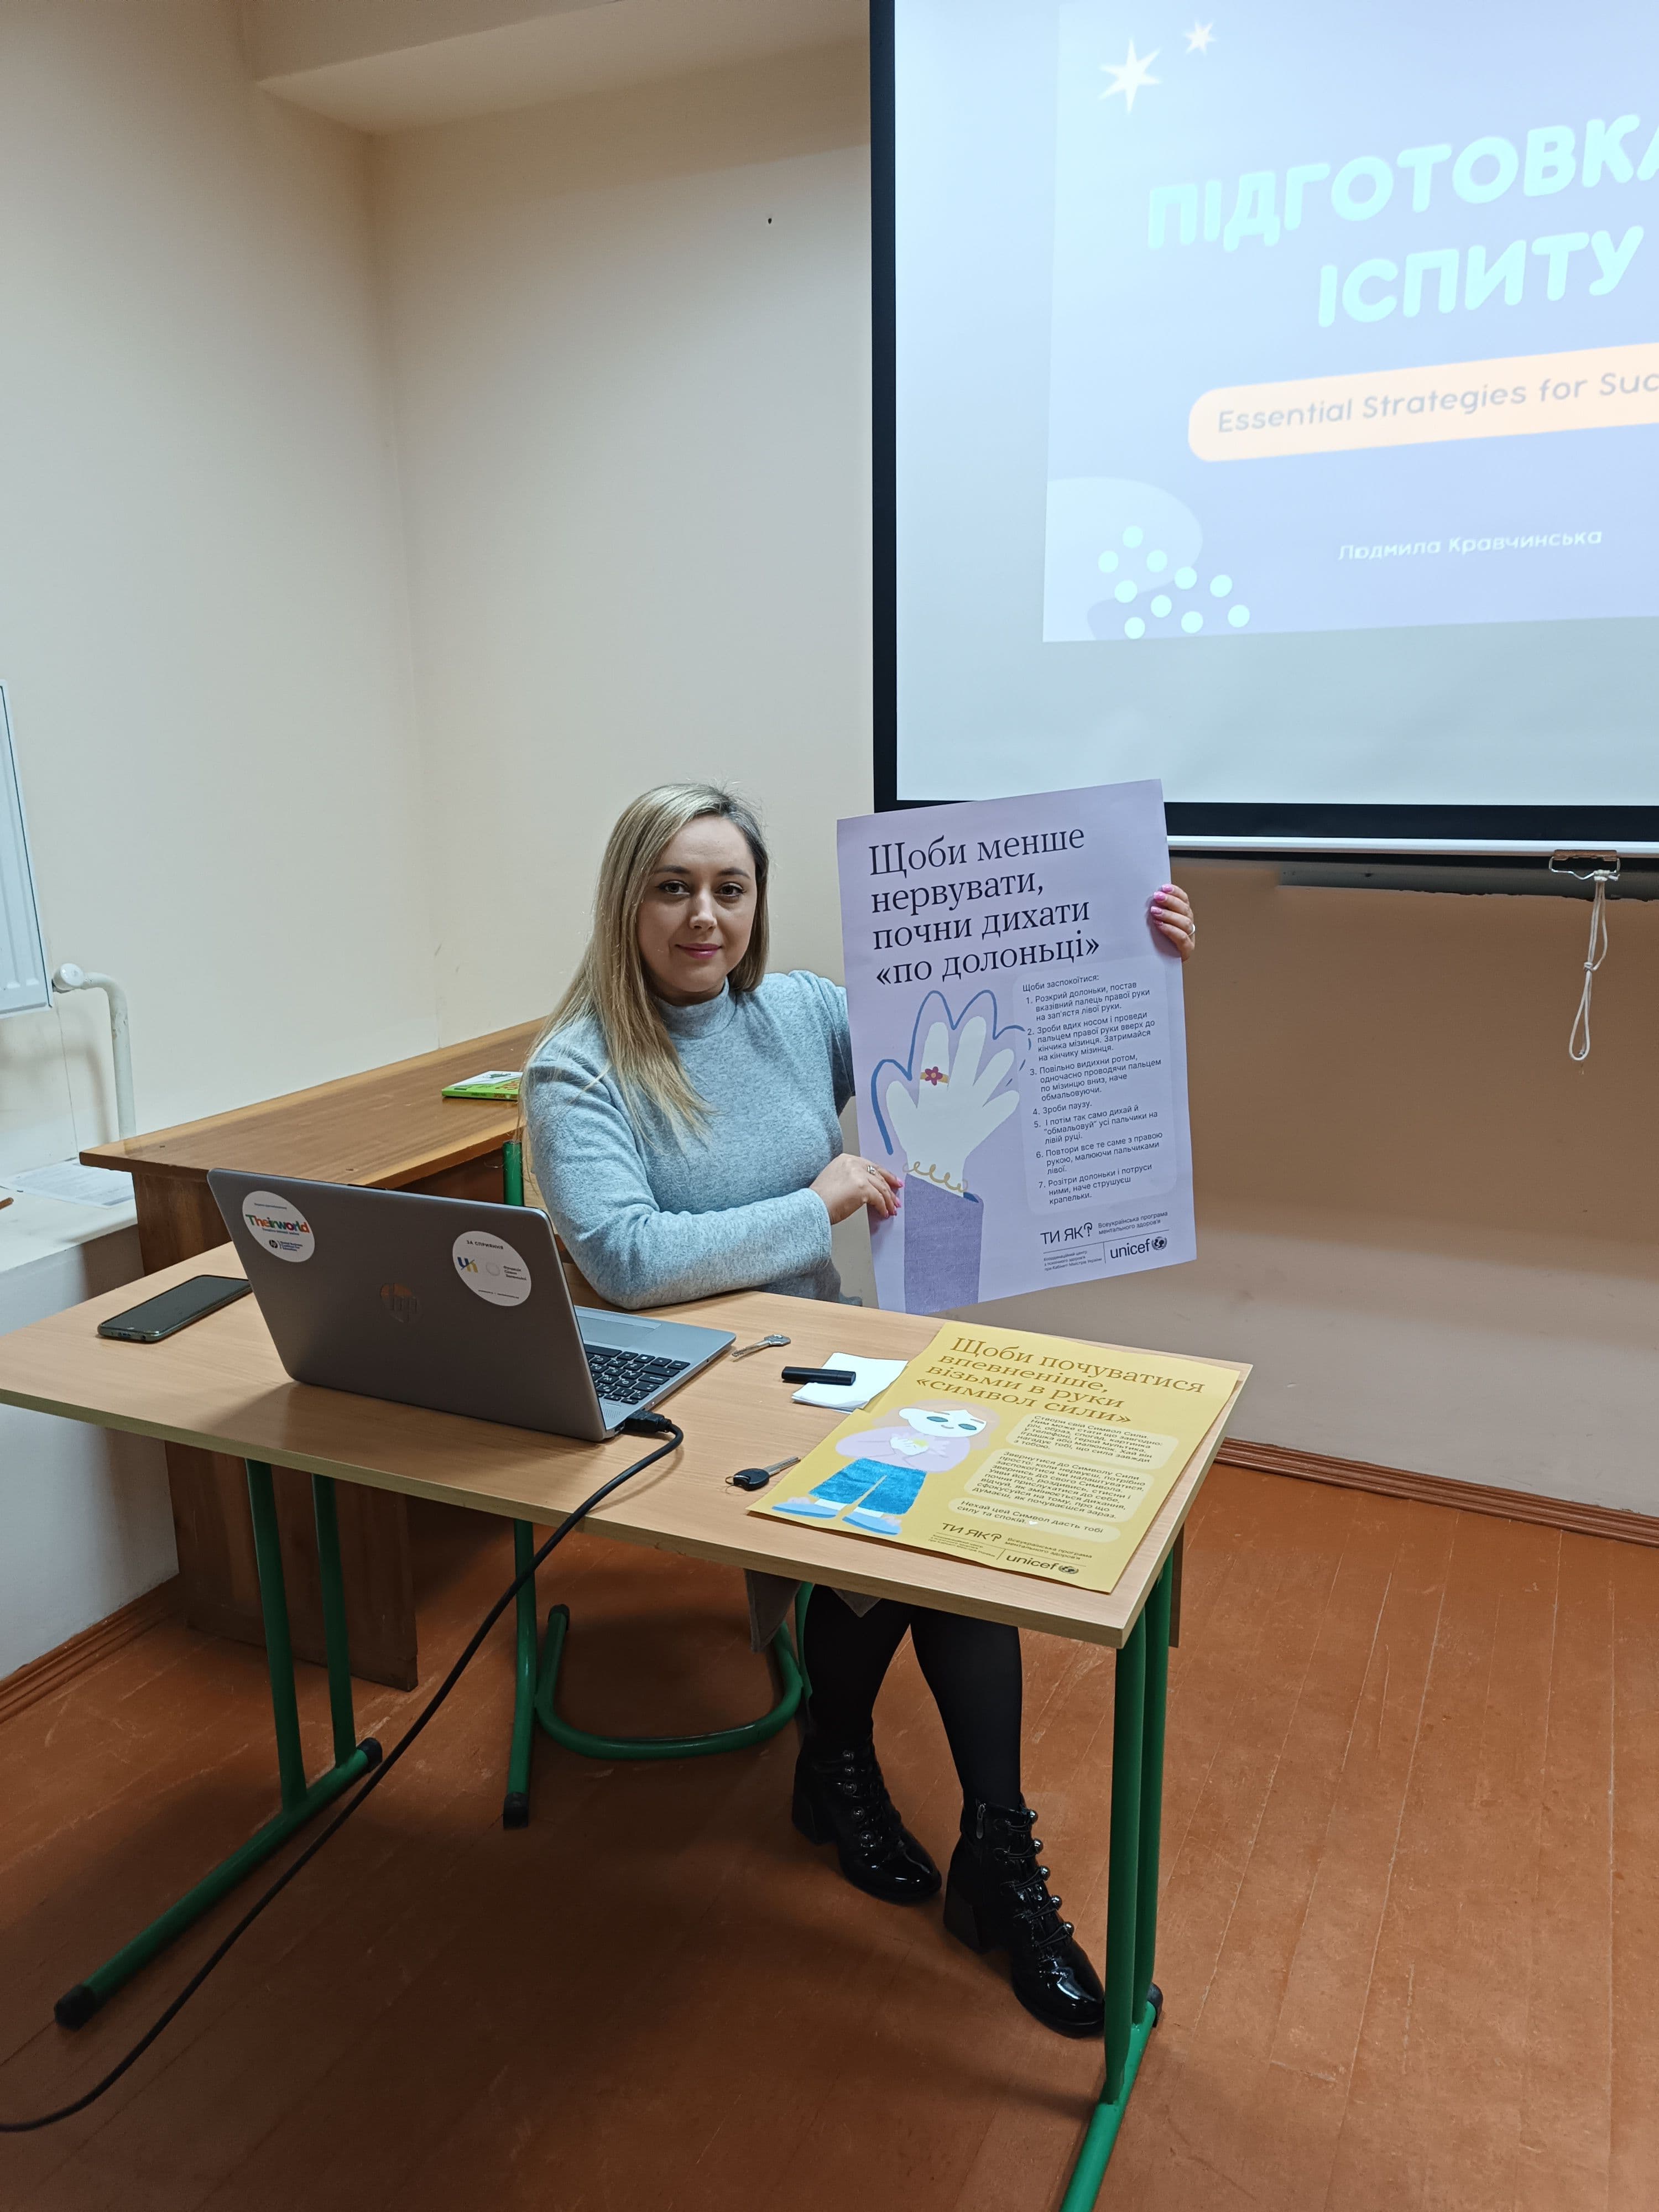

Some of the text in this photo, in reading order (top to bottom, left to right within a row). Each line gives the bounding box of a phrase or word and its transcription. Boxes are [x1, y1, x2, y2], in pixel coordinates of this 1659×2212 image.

[1318, 226, 1644, 327] ІСПИТУ
[1218, 398, 1353, 434] Essential
[1362, 384, 1527, 415] Strategies
[1540, 378, 1588, 403] for
[1338, 530, 1603, 561] Людмила Кравчинська
[868, 829, 1084, 879] Щоби менше
[871, 873, 1043, 916] нервувати,
[873, 901, 1089, 950] почни дихати
[877, 930, 1099, 985] «по долоньці»
[1022, 975, 1099, 992] Щоби заспокоїтися:
[1035, 991, 1067, 1003] Розкрий
[1069, 987, 1108, 999] долоньки,
[1110, 982, 1136, 991] постав
[1036, 989, 1150, 1012] вказівний палець правої руки
[1081, 1004, 1100, 1014] лівої
[1101, 1003, 1121, 1013] руки.
[1037, 1024, 1061, 1035] Зроби
[1063, 1021, 1081, 1030] вдих
[1083, 1018, 1108, 1026] носом
[1114, 1012, 1147, 1023] проведи
[1037, 1032, 1071, 1043] пальцем
[1073, 1026, 1099, 1039] правої
[1100, 1026, 1119, 1035] руки
[1120, 1022, 1143, 1030] вверх
[1038, 1030, 1150, 1052] кінчика мізинця. Затримайся
[1050, 1050, 1078, 1060] кінчику
[1081, 1045, 1114, 1055] мізинця.
[1040, 1063, 1074, 1074] Повільно
[1077, 1058, 1109, 1068] видихни
[1112, 1054, 1138, 1065] ротом,
[1040, 1059, 1161, 1084] одночасно проводячи пальцем
[1041, 1087, 1102, 1102] обмальовуючи.
[1052, 1080, 1085, 1091] мізинцю
[1042, 1104, 1066, 1115] Зроби
[1068, 1101, 1092, 1110] паузу.
[1050, 1117, 1071, 1125] потім
[1088, 1111, 1107, 1119] само
[1109, 1105, 1132, 1117] дихай
[1099, 1118, 1109, 1128] усі
[1112, 1113, 1147, 1124] пальчики
[1045, 1131, 1082, 1145] лівій руці.
[1046, 1146, 1079, 1157] Повтори
[1107, 1138, 1126, 1146] саме
[1134, 1132, 1162, 1143] правою
[1046, 1142, 1159, 1167] рукою, малюючи пальчиками
[1047, 1165, 1067, 1175] лівої.
[1048, 1177, 1077, 1187] Розітри
[1079, 1170, 1115, 1183] долоньки
[1121, 1164, 1152, 1175] потруси
[1048, 1177, 1131, 1196] ними, наче струшуєш
[1049, 1192, 1092, 1206] крапельки.
[245, 1214, 310, 1233] Theirworld
[1040, 1222, 1093, 1244] ТИ ЯК?
[1110, 1238, 1150, 1259] unicef
[938, 1355, 1108, 1393] впевненіше,
[950, 1337, 1205, 1393] Щоби почуватися
[925, 1366, 1124, 1408] візьми в руки
[916, 1379, 1131, 1423] «символ сили»
[957, 1506, 979, 1514] силу
[961, 1500, 990, 1510] Нехай
[1013, 1511, 1050, 1522] Символ
[1051, 1520, 1080, 1528] дасть
[1006, 1555, 1060, 1570] unicef
